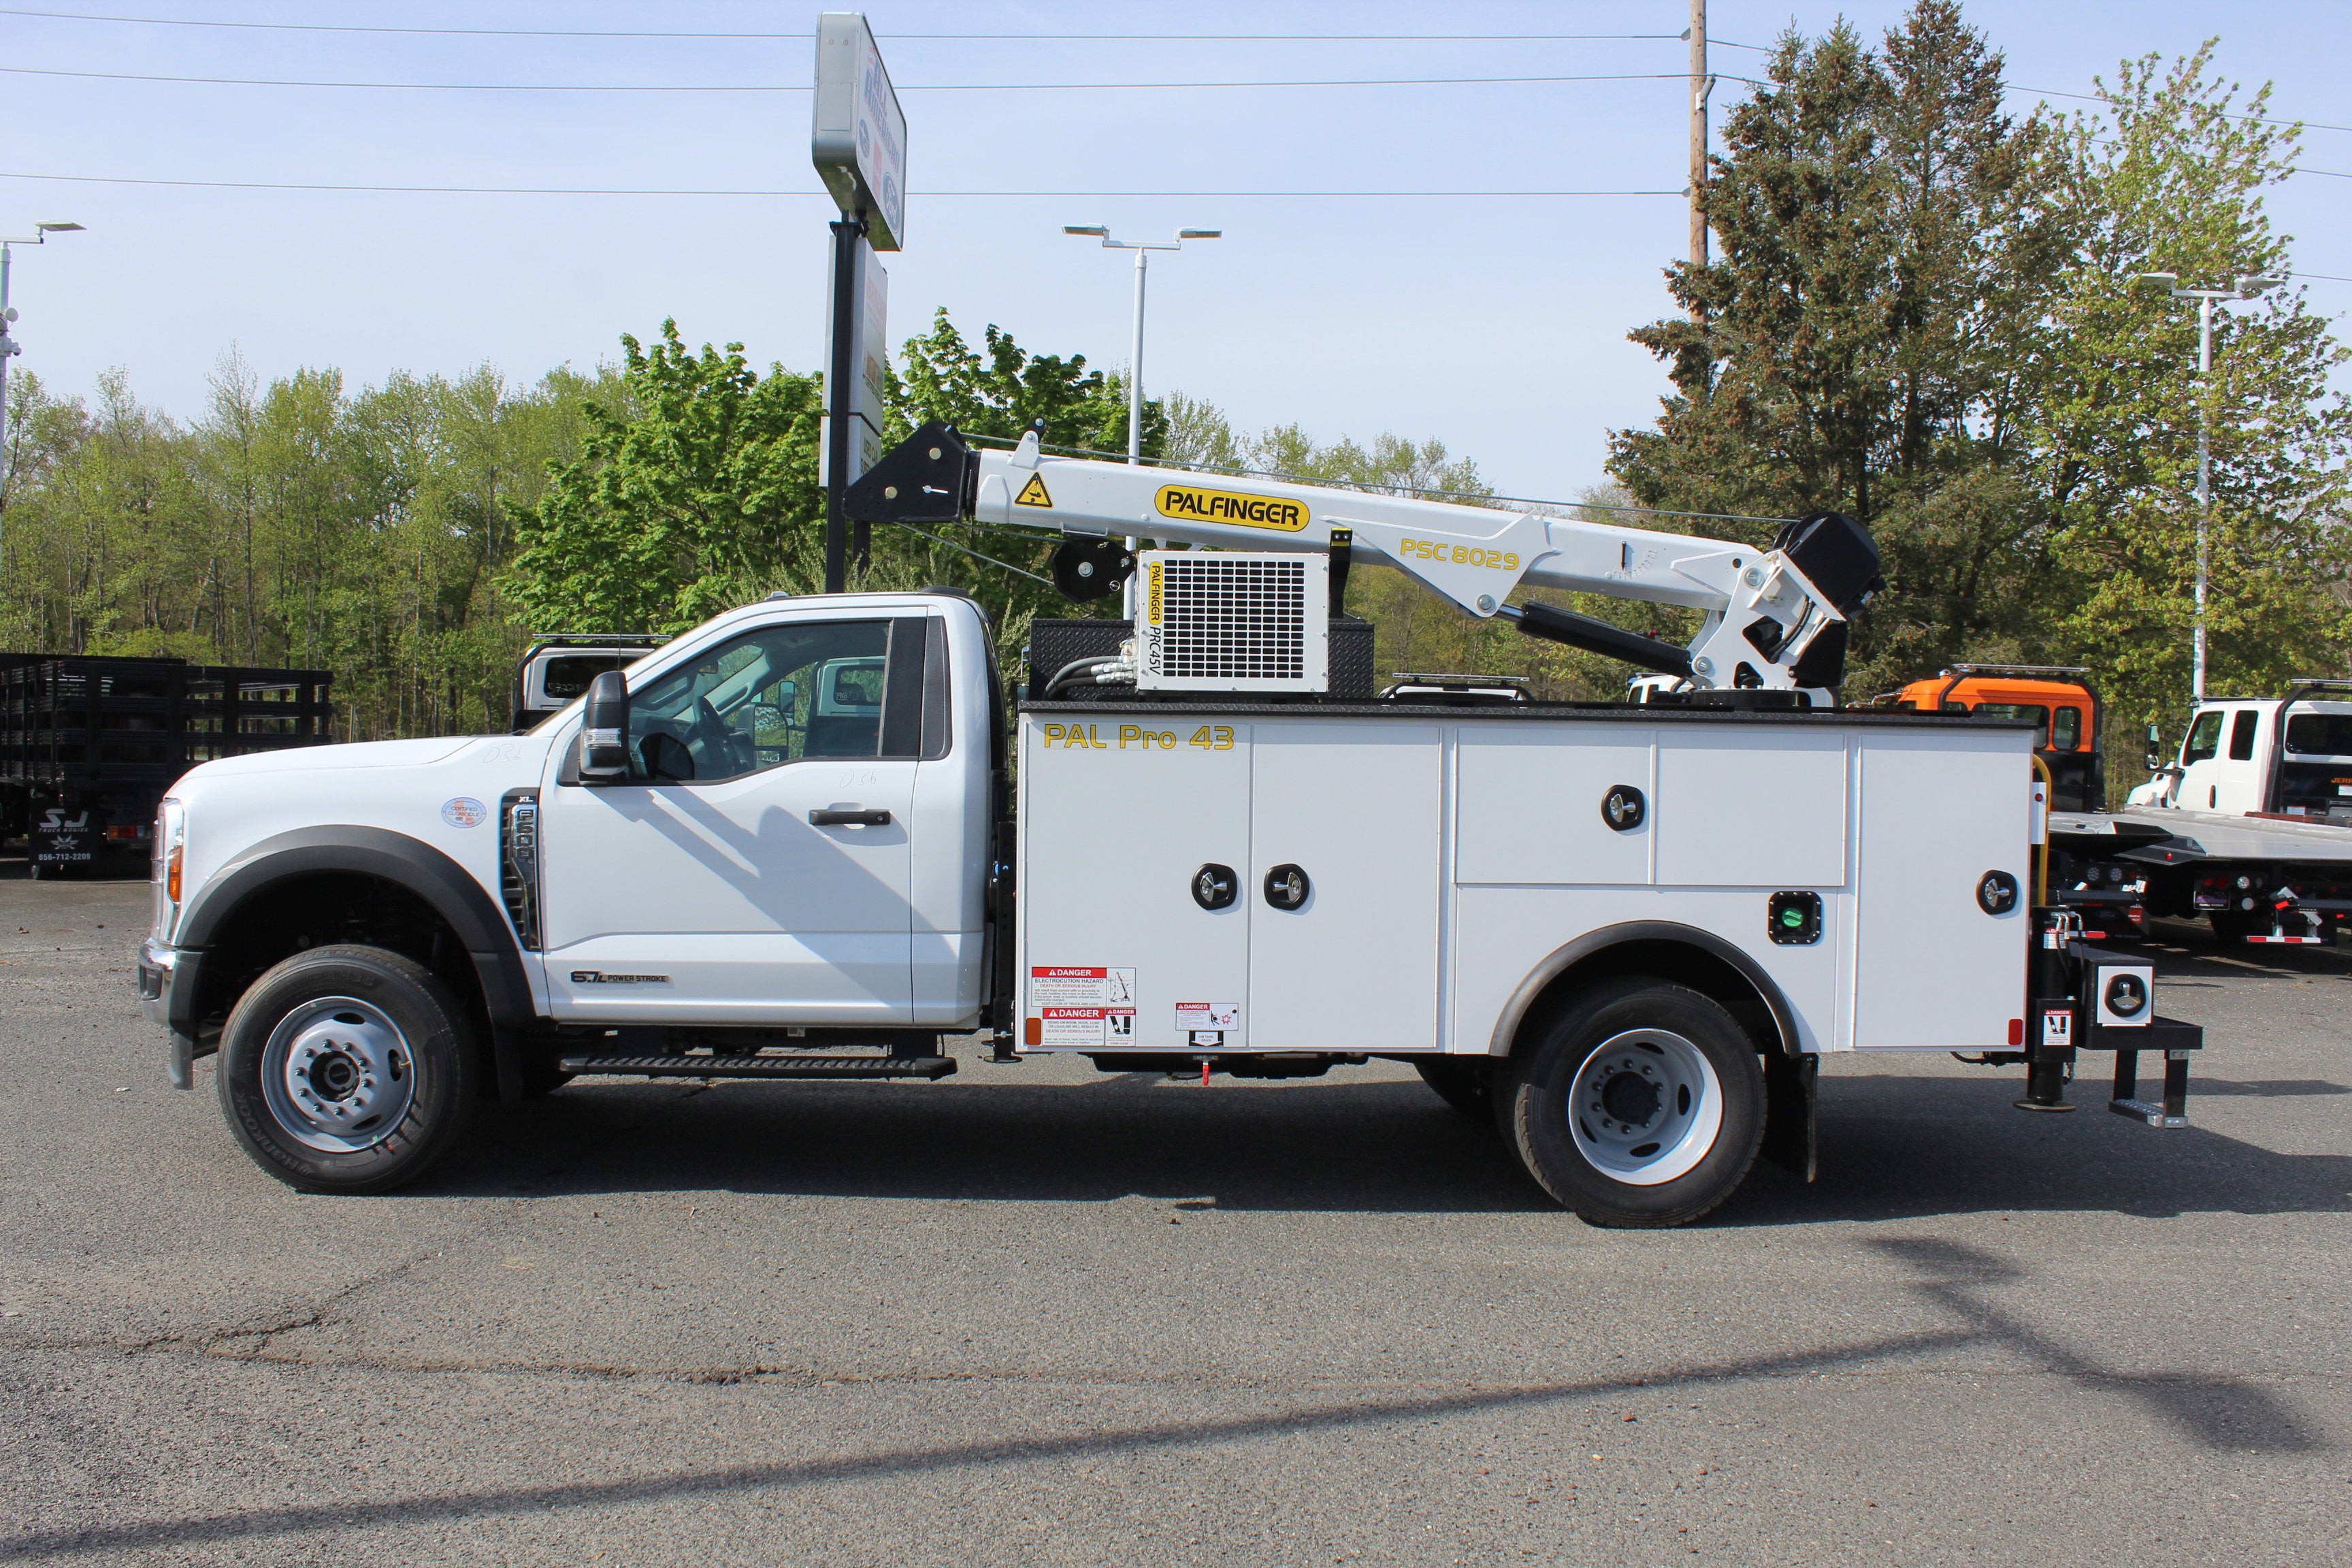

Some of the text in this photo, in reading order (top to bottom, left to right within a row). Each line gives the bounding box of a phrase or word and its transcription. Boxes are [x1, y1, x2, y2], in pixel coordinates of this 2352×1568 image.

[1165, 491, 1299, 526] PALFINGER
[1401, 538, 1519, 570] PSC 8029
[1151, 566, 1160, 621] PALFINGER
[1149, 626, 1161, 675] PRC45V
[1045, 723, 1235, 750] PAL Pro 43
